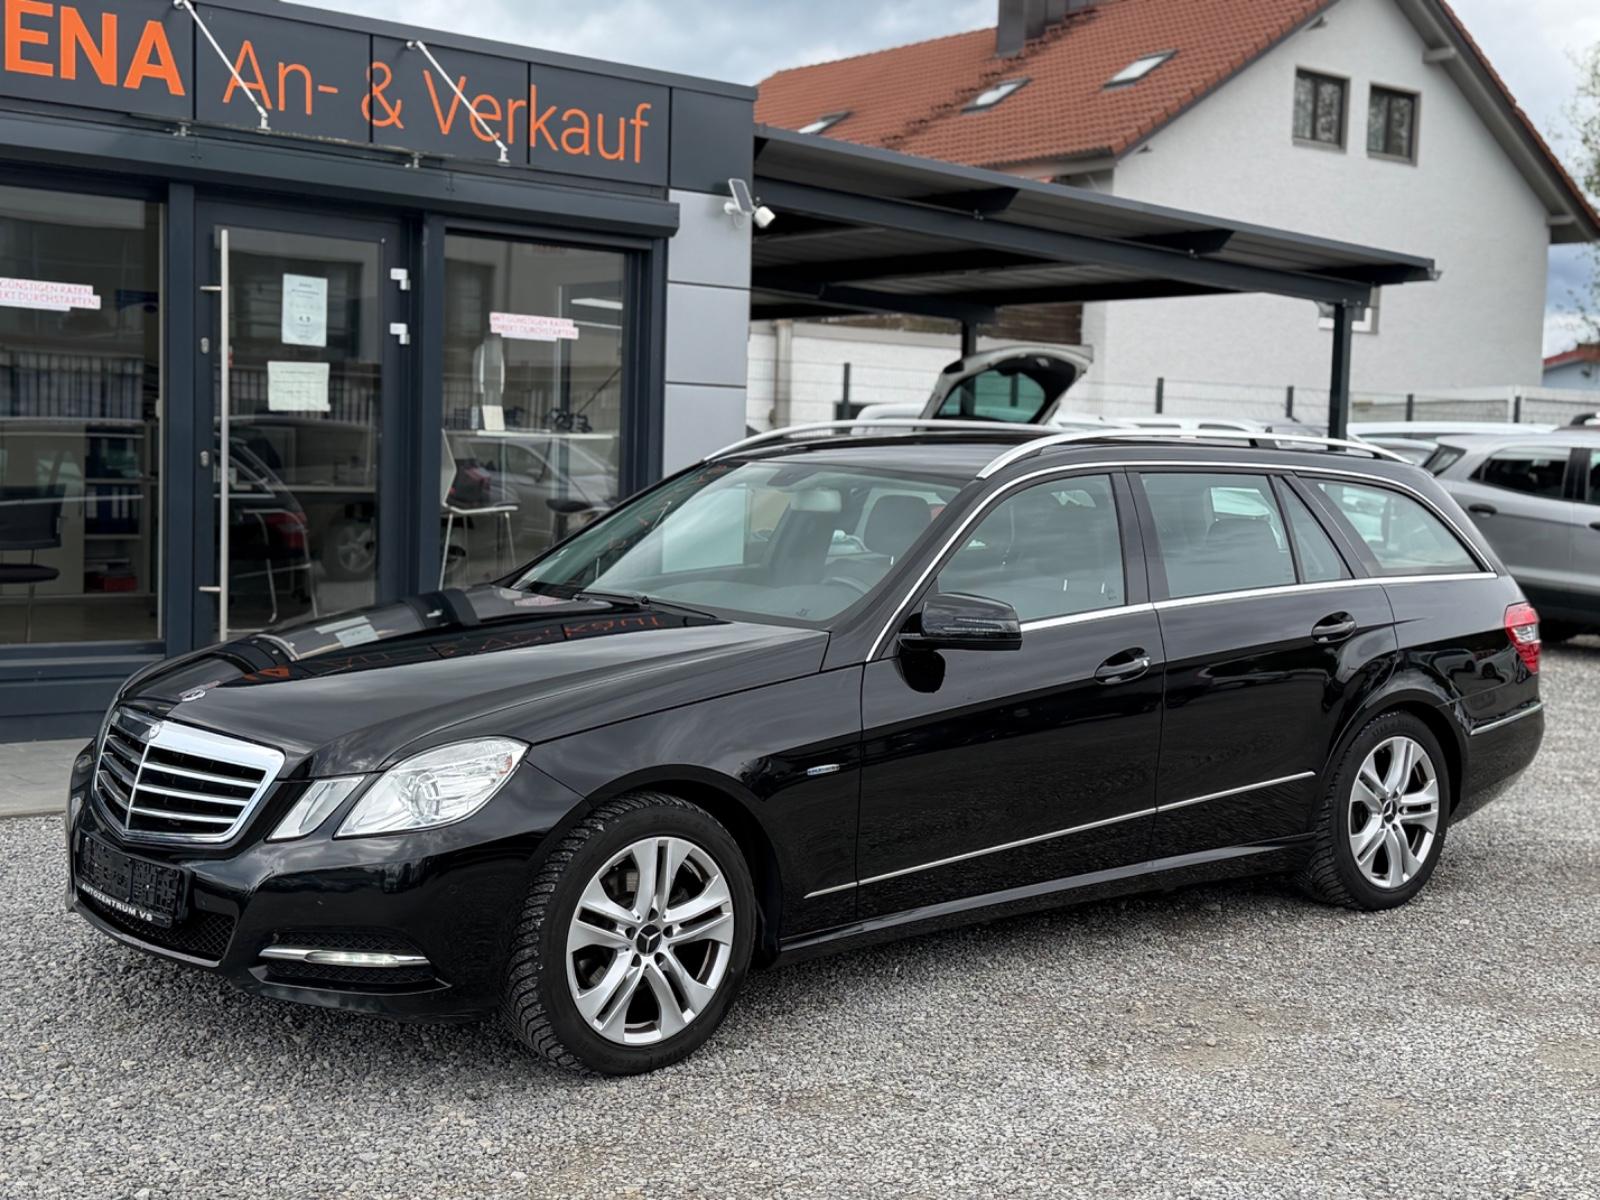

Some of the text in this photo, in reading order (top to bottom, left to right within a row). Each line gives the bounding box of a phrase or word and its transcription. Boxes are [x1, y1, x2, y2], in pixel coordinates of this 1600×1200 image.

[4, 0, 651, 164] ENA An- & Verkauf
[81, 883, 137, 916] AUTOZENTRUM
